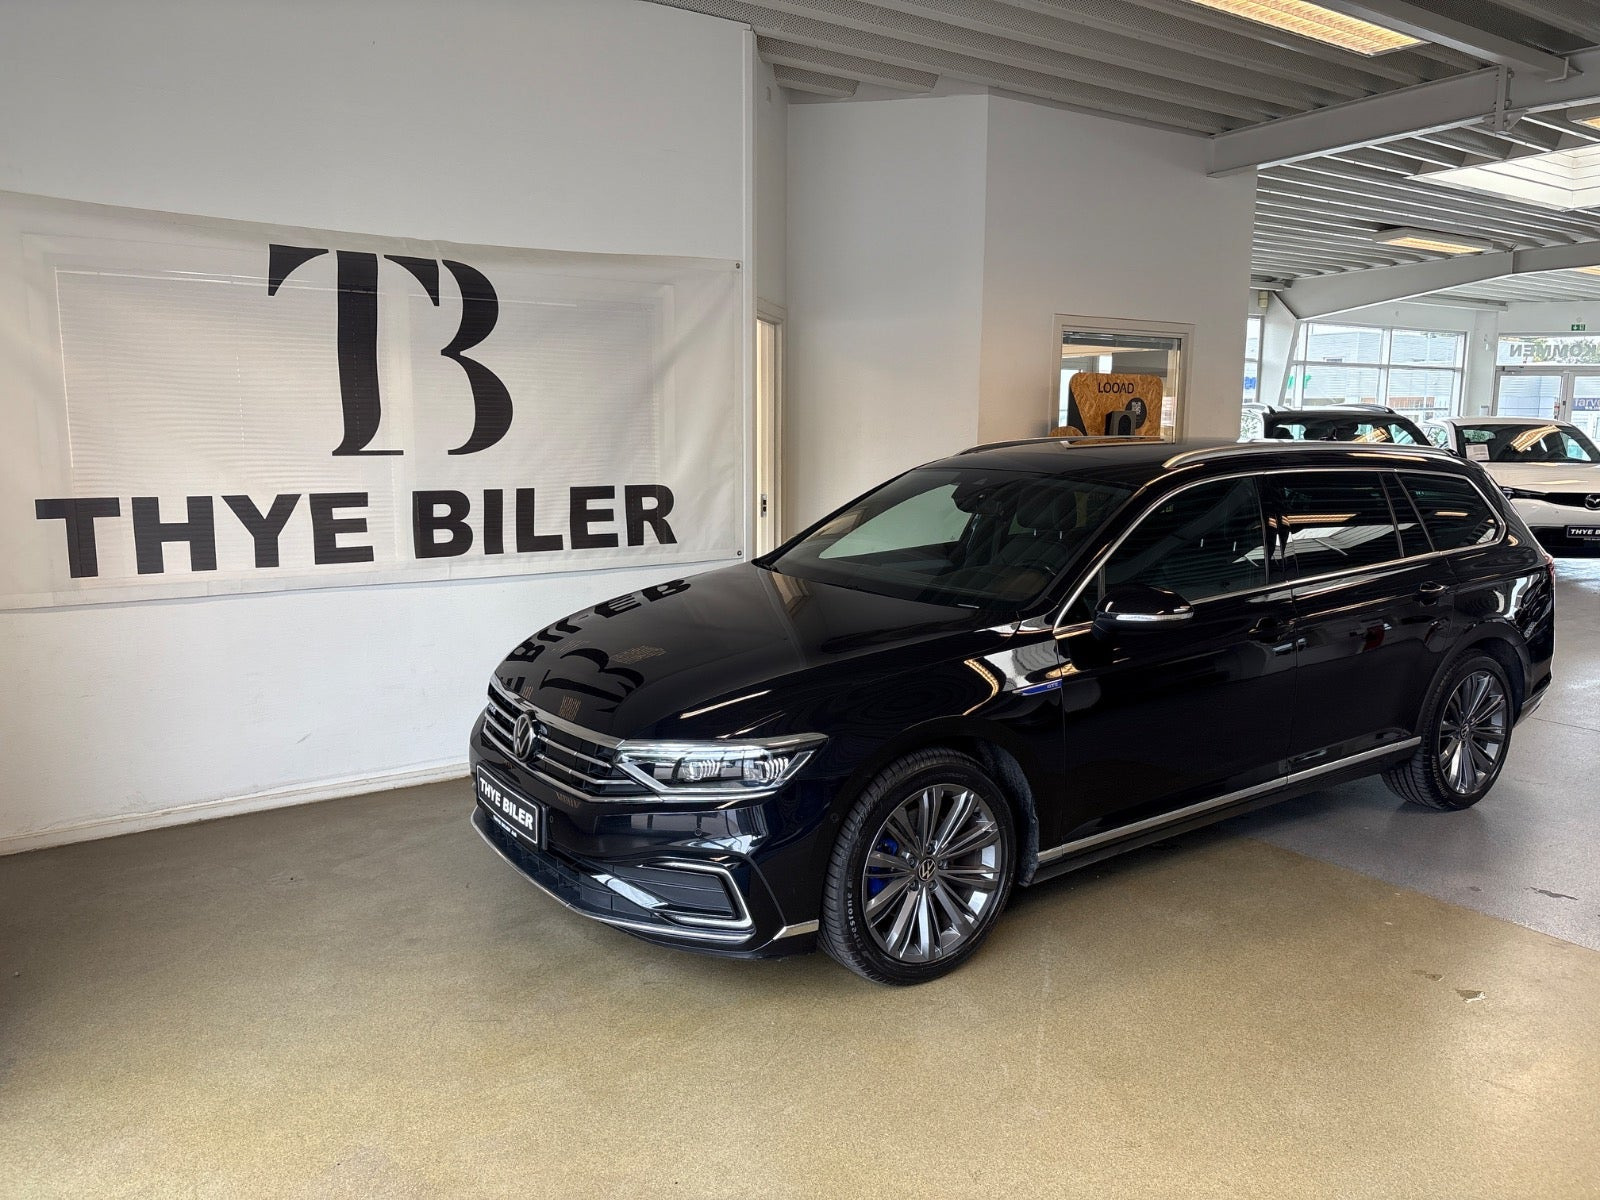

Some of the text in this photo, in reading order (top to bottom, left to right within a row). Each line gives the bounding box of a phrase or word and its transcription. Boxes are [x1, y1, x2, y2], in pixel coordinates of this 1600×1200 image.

[1098, 382, 1135, 394] LOOAD
[35, 484, 678, 578] THYE BILER
[480, 777, 501, 807] THYE
[502, 797, 533, 830] BILER
